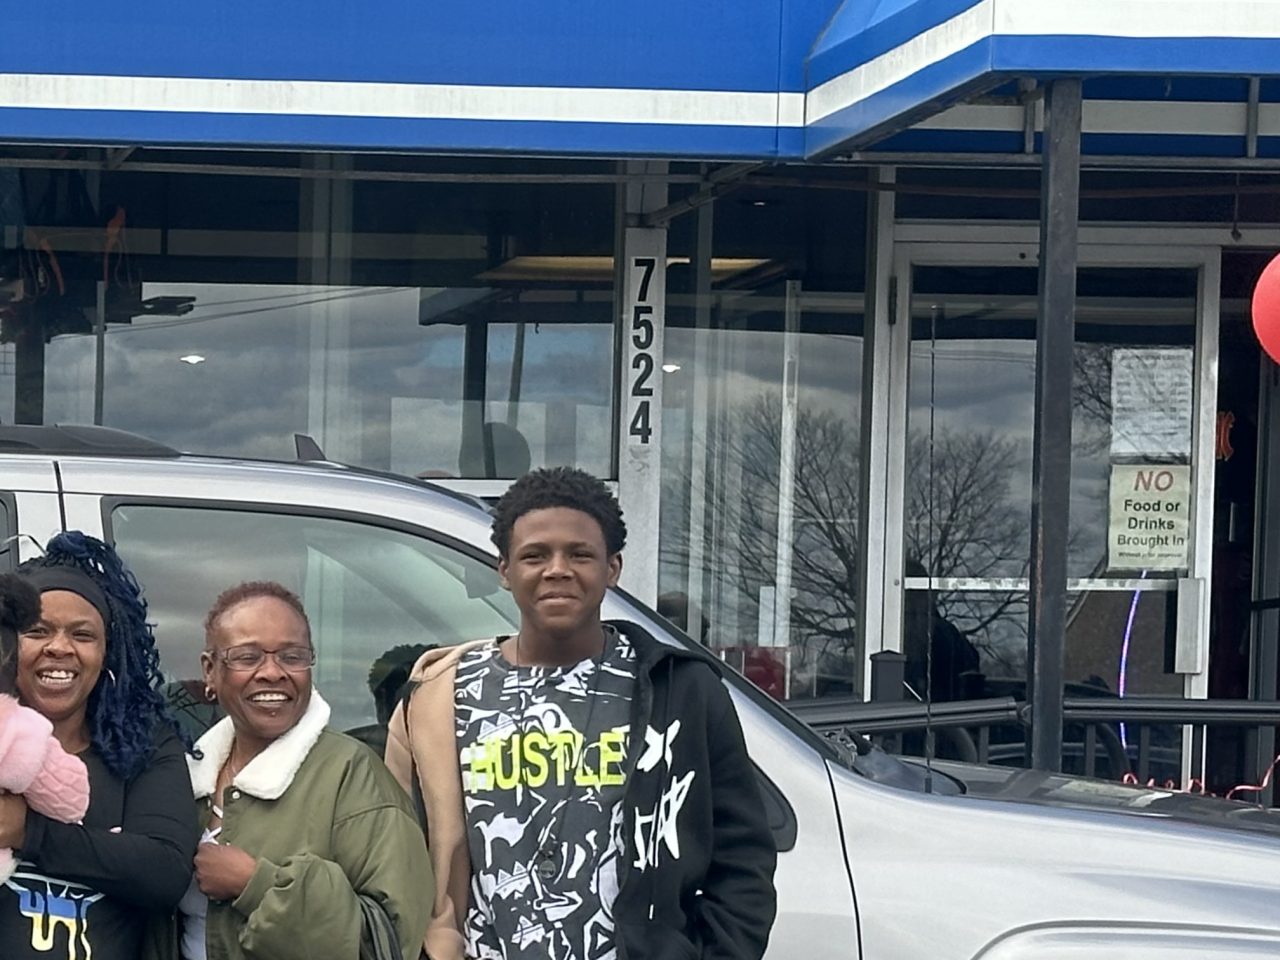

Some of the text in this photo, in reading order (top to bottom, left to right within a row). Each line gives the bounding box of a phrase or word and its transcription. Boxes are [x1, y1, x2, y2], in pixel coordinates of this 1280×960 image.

[629, 258, 656, 444] 7524
[1134, 470, 1174, 491] NO
[1124, 499, 1181, 512] Food or
[1128, 517, 1175, 530] Drinks
[1117, 534, 1185, 549] Brought In
[470, 731, 625, 793] HUSTLE
